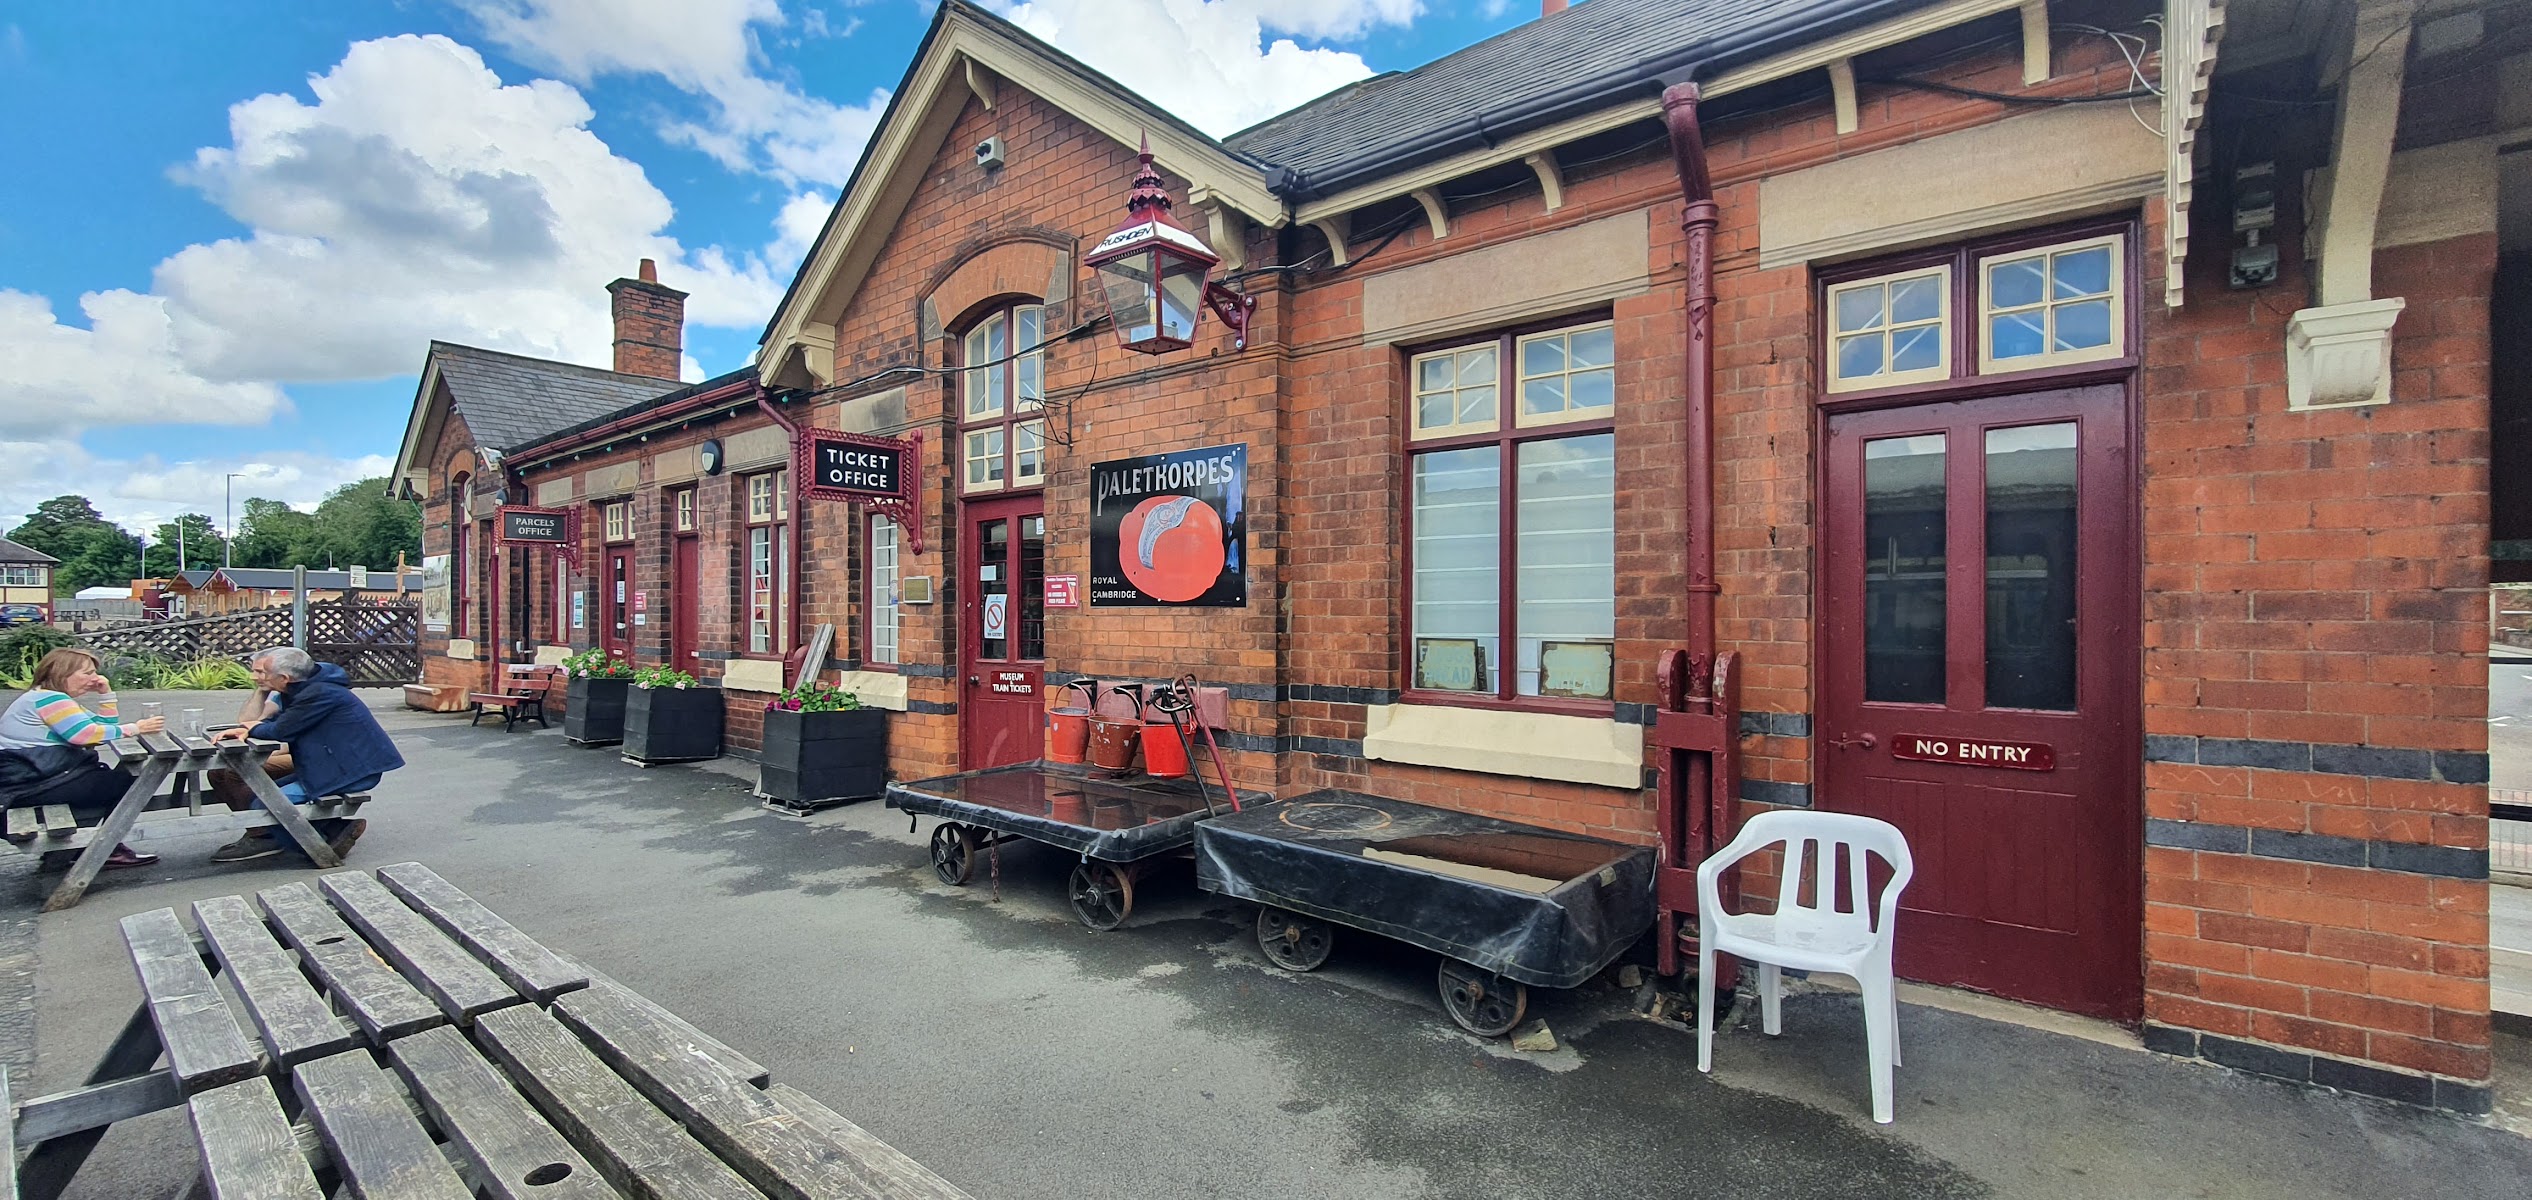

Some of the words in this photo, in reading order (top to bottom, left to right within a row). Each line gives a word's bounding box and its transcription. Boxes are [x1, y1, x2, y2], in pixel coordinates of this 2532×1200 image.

[1100, 225, 1153, 248] RUSHDEN
[826, 448, 890, 470] TICKET
[829, 469, 888, 488] OFFICE
[515, 517, 555, 527] PARCELS
[518, 527, 553, 536] OFFICE
[1092, 576, 1118, 585] ROYAL
[1092, 590, 1137, 599] CAMBRIDGE
[1000, 672, 1024, 681] MUSEUM
[992, 683, 1009, 692] TRAIN
[1010, 684, 1032, 693] TICKETS
[1916, 739, 1949, 756] NO
[1959, 743, 2031, 762] ENTRY
